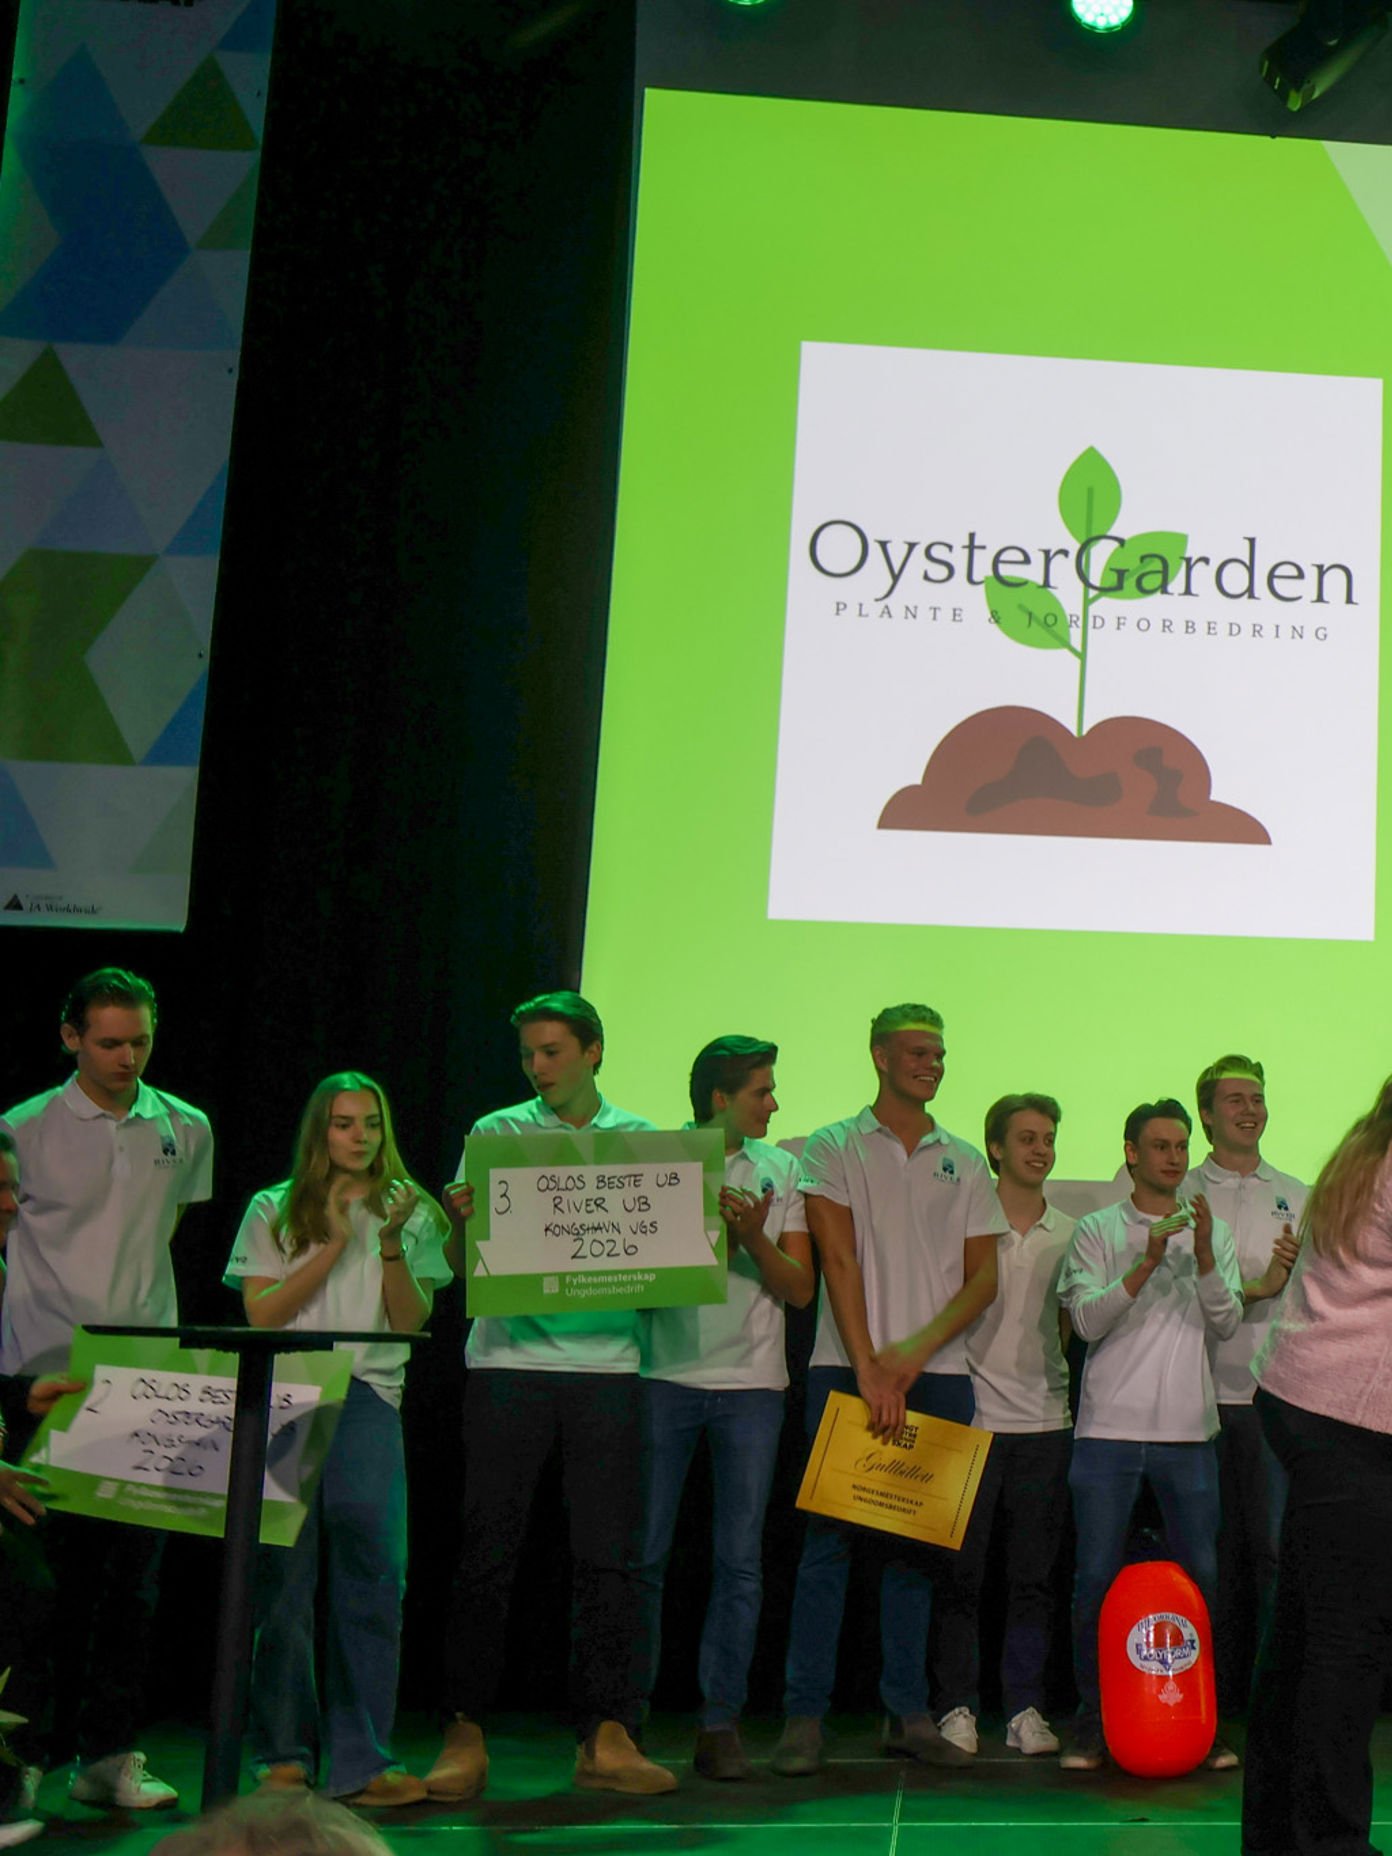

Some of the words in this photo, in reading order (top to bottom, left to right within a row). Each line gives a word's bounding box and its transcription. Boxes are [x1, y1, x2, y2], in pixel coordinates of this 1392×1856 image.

[808, 518, 1359, 607] OysterGarden
[834, 601, 966, 624] PLANTE
[988, 609, 1003, 625] &
[1026, 611, 1330, 642] JORDFORBEDRING
[536, 1174, 586, 1192] OSLOS
[596, 1173, 643, 1190] BESTE
[655, 1172, 681, 1188] UB
[553, 1196, 609, 1215] RIVER
[623, 1195, 651, 1212] UB
[544, 1221, 621, 1237] KONGSHAVN
[630, 1221, 659, 1235] VGS
[571, 1238, 639, 1260] 2026
[565, 1272, 656, 1286] Fylkesmesterskap
[565, 1284, 645, 1297] Ungdomsbedrift
[198, 1385, 238, 1405] BEST
